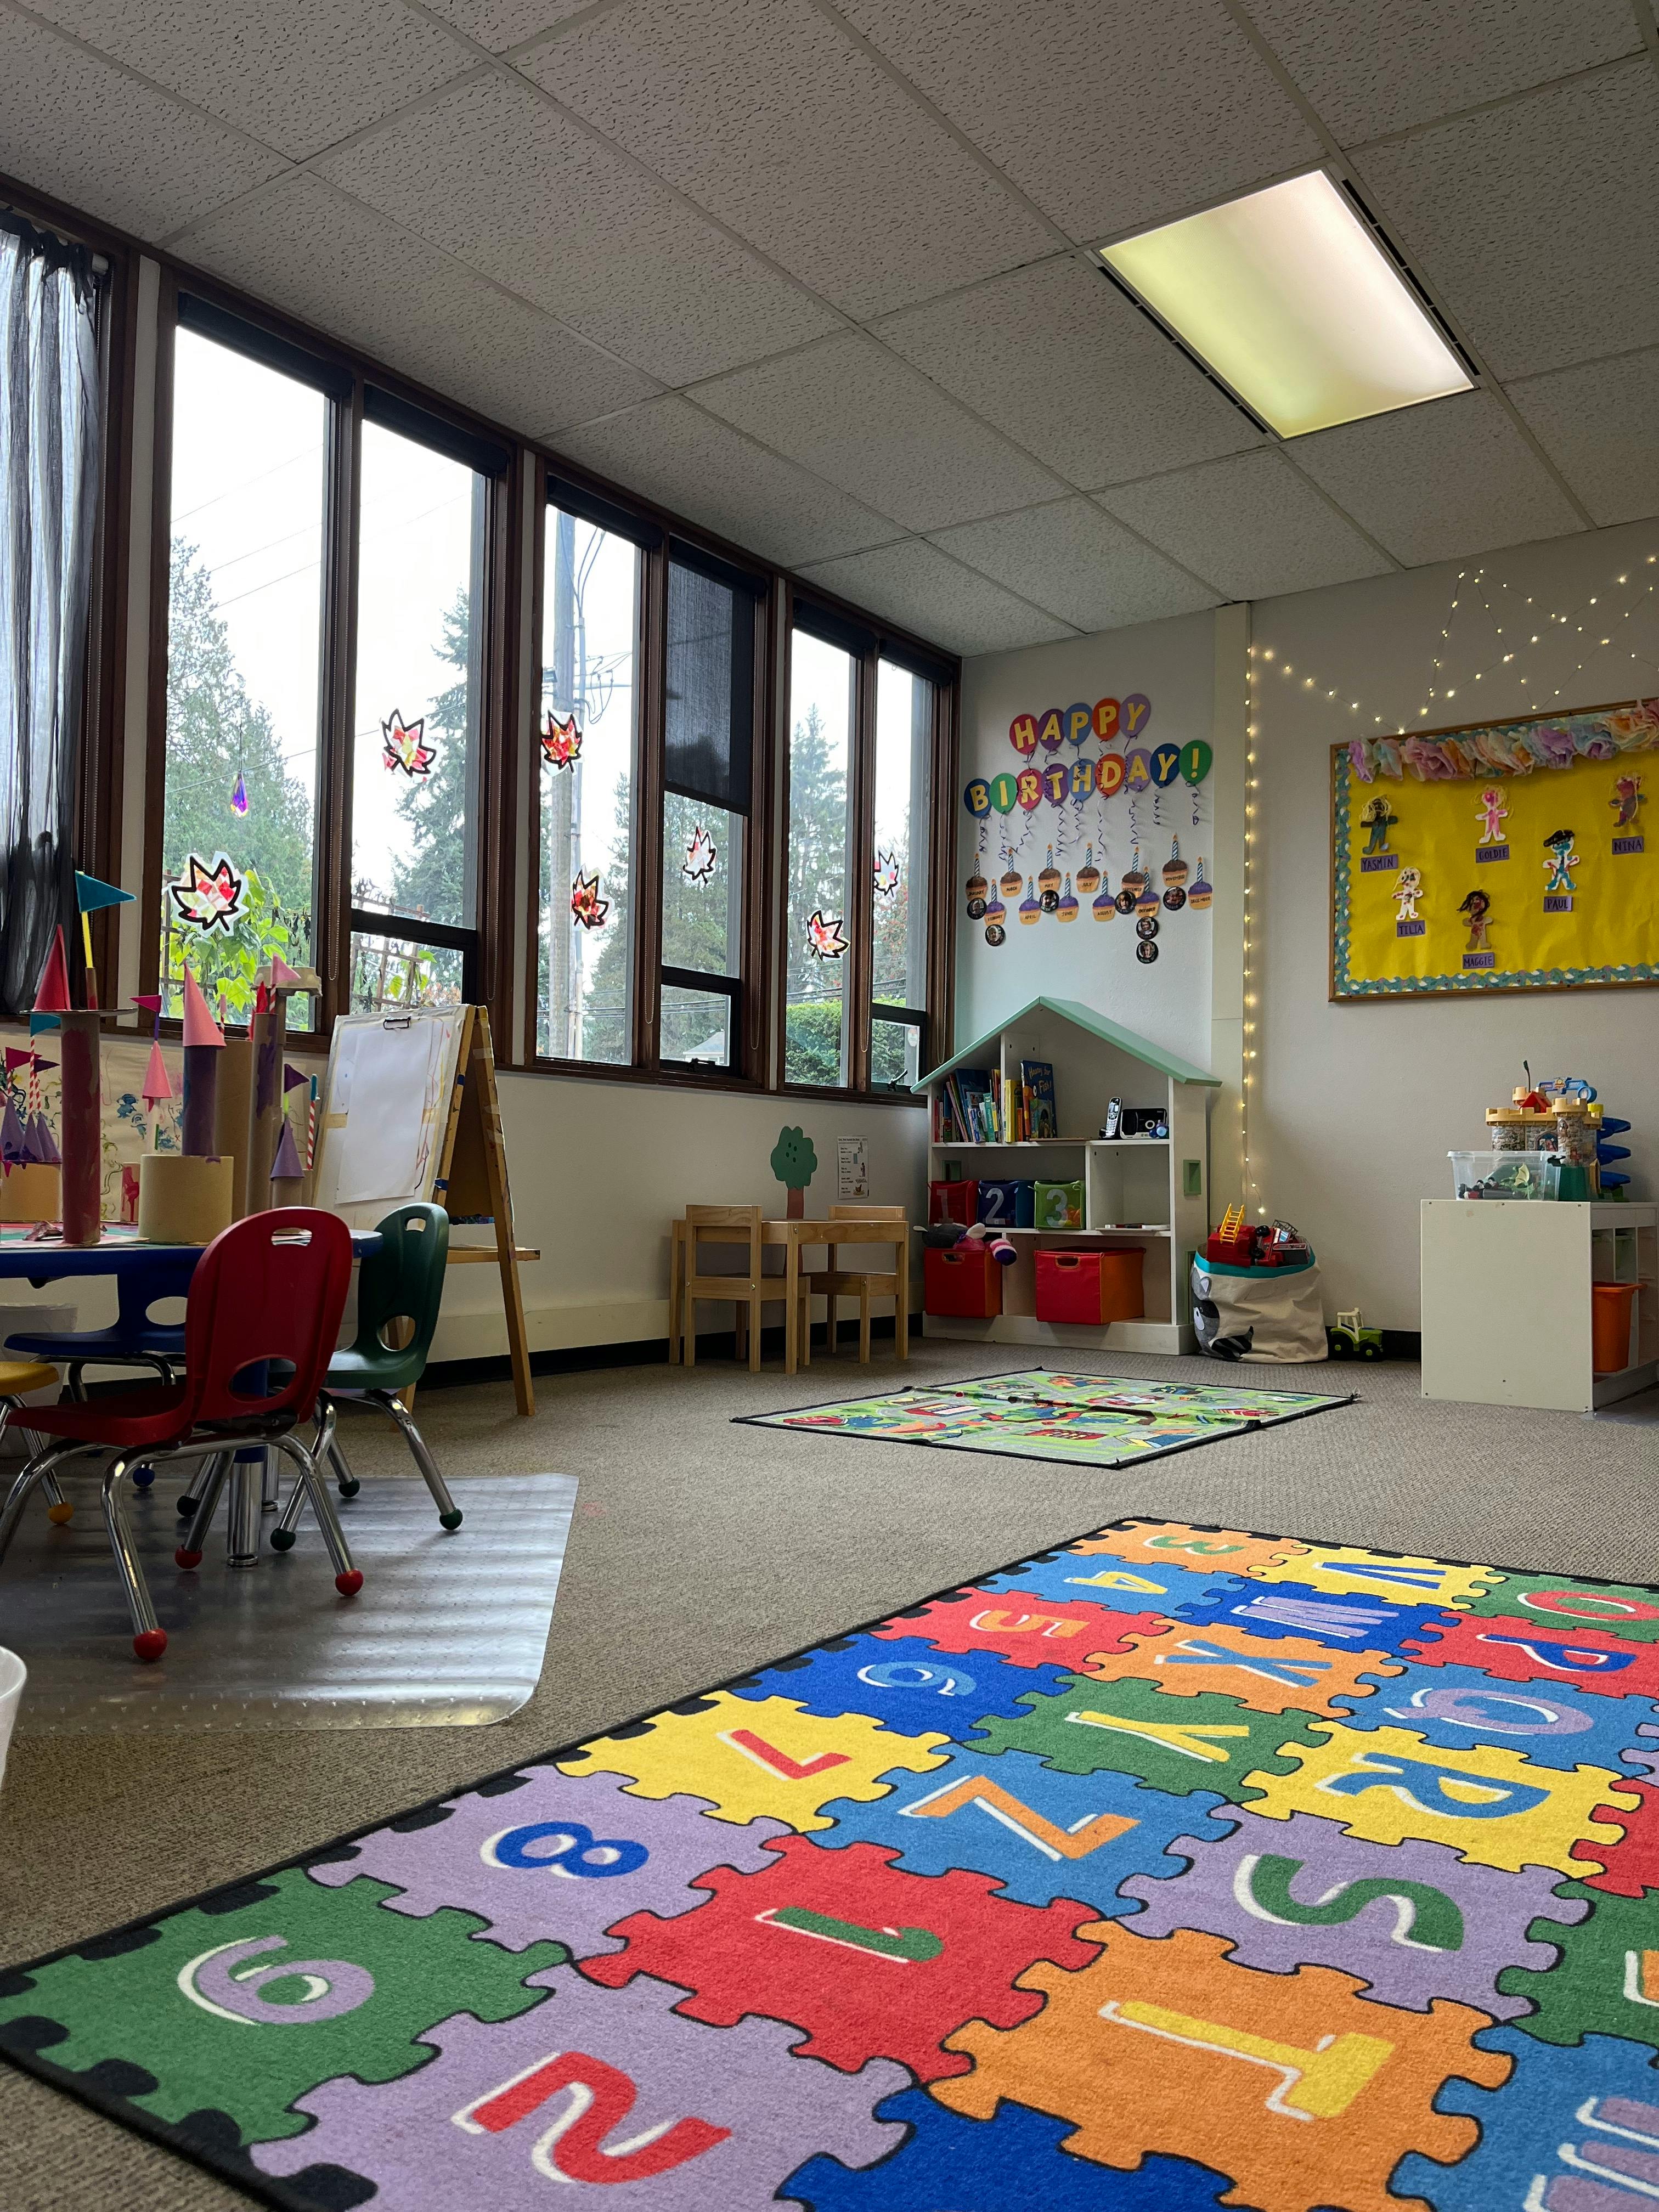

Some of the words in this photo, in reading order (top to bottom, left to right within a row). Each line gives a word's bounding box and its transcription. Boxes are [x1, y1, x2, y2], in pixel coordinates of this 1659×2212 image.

[1013, 702, 1146, 749] HAPPY
[972, 748, 1200, 812] BIRTHDAY!
[1362, 856, 1393, 871] YASMIN
[1479, 848, 1508, 861] GOLDIE
[1613, 839, 1642, 851] NINA
[1547, 898, 1568, 910] PAUL
[1399, 924, 1424, 935] TILIA
[1464, 955, 1493, 967] MAGGIE
[936, 1189, 955, 1224] 1
[985, 1188, 1006, 1225] 2
[1046, 1188, 1068, 1228] 3
[1143, 1536, 1246, 1555] 3
[1063, 1571, 1168, 1594] 4
[1313, 1561, 1447, 1590] V
[970, 1609, 1091, 1638] 5
[1154, 1639, 1333, 1689] X
[1476, 1633, 1638, 1672] P
[1383, 1687, 1594, 1736] Q
[1064, 1711, 1249, 1763] Y
[1314, 1752, 1551, 1819] R
[898, 1775, 1142, 1861] Z
[480, 1821, 650, 1878] 8
[1233, 1853, 1465, 1951] S
[1098, 2001, 1396, 2121] T
[450, 2050, 732, 2186] 2
